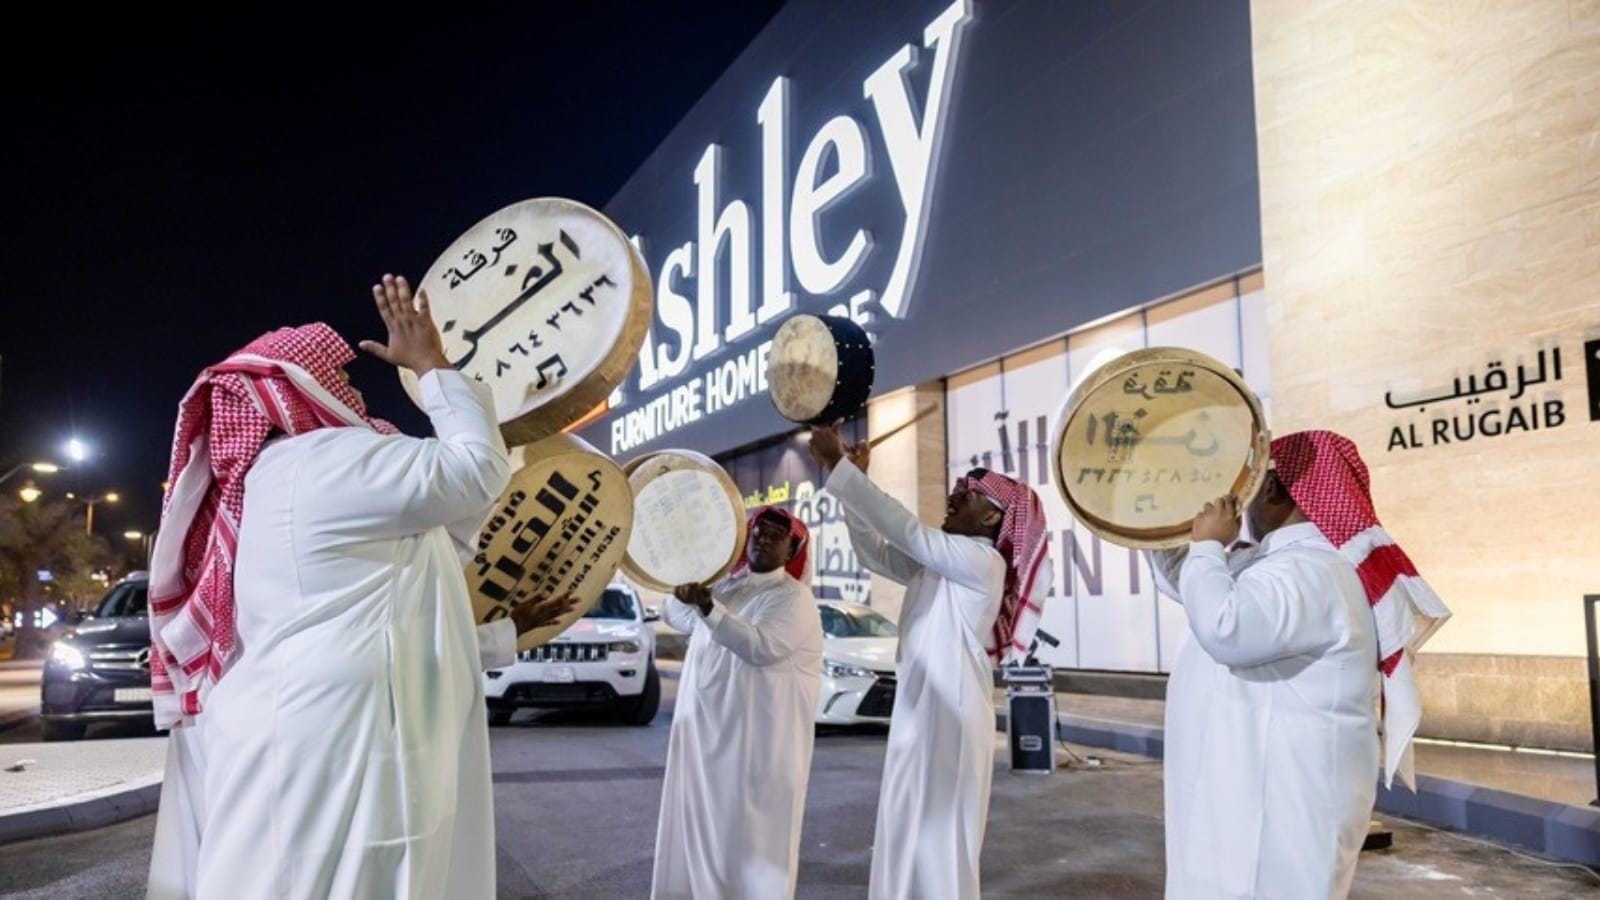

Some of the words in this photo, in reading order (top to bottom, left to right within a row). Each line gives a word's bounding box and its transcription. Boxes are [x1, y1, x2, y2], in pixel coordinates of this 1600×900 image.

[441, 227, 518, 291] فرقة
[1384, 347, 1562, 413] الرقيب
[611, 378, 701, 456] FURNITURE
[1387, 423, 1424, 452] AL
[1432, 399, 1566, 446] RUGAIB
